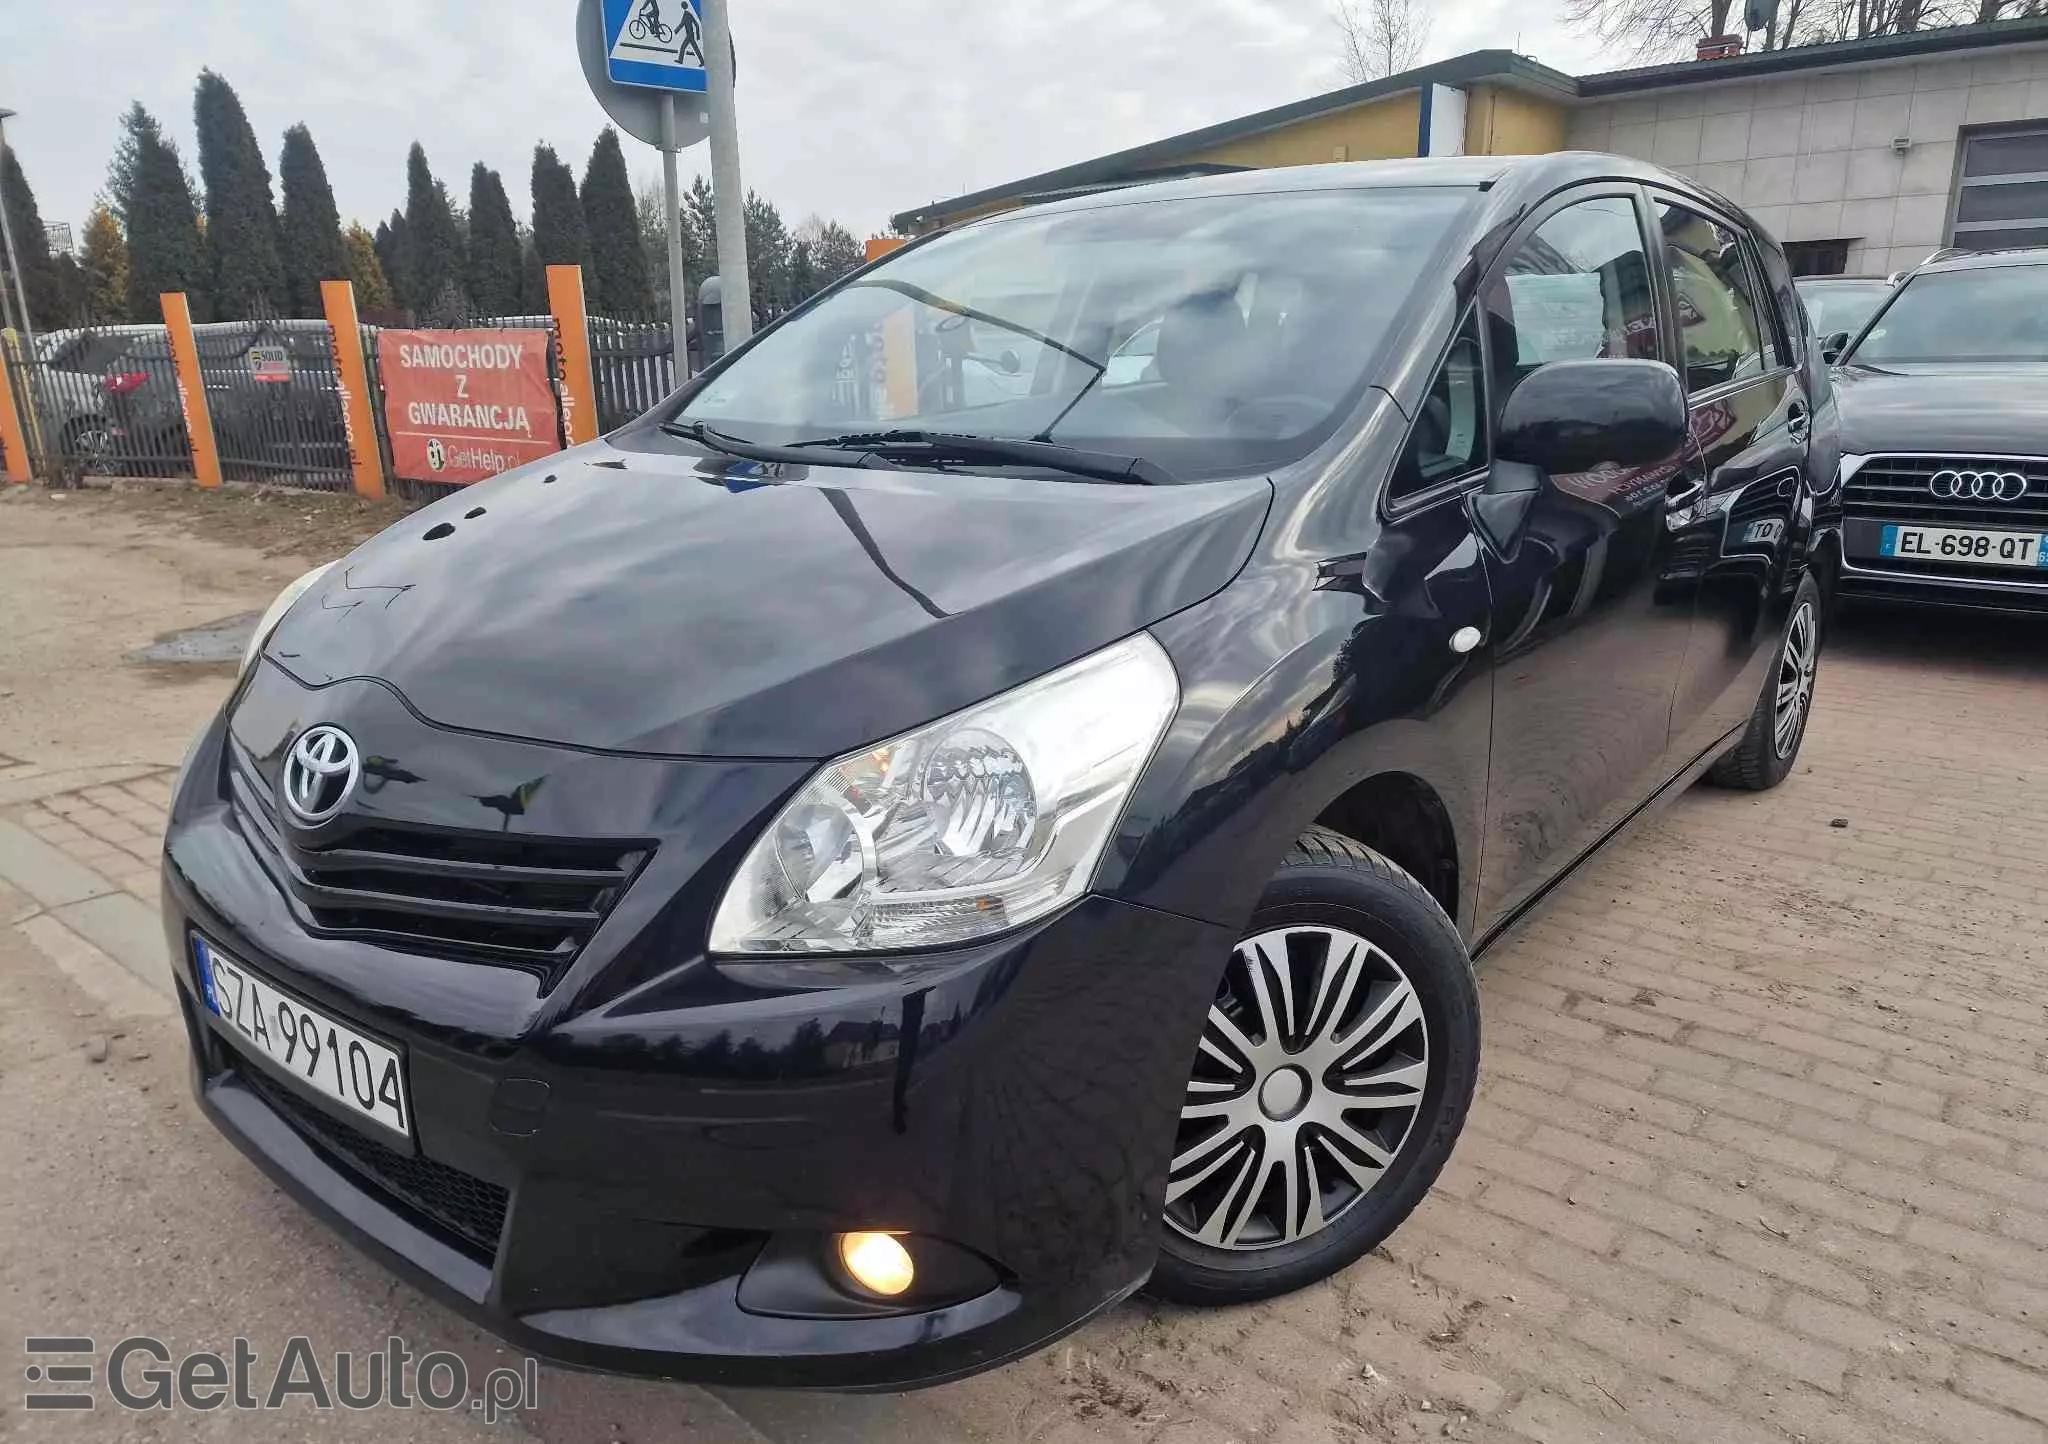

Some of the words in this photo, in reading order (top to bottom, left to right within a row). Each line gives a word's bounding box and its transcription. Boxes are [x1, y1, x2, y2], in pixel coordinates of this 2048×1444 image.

[400, 344, 523, 369] SAMOCHODY
[455, 374, 469, 398] Z
[408, 401, 532, 438] GWARANCJĄ
[1900, 532, 2034, 560] EL-698-QT
[212, 957, 271, 1051] SZA
[277, 1001, 405, 1129] 99104
